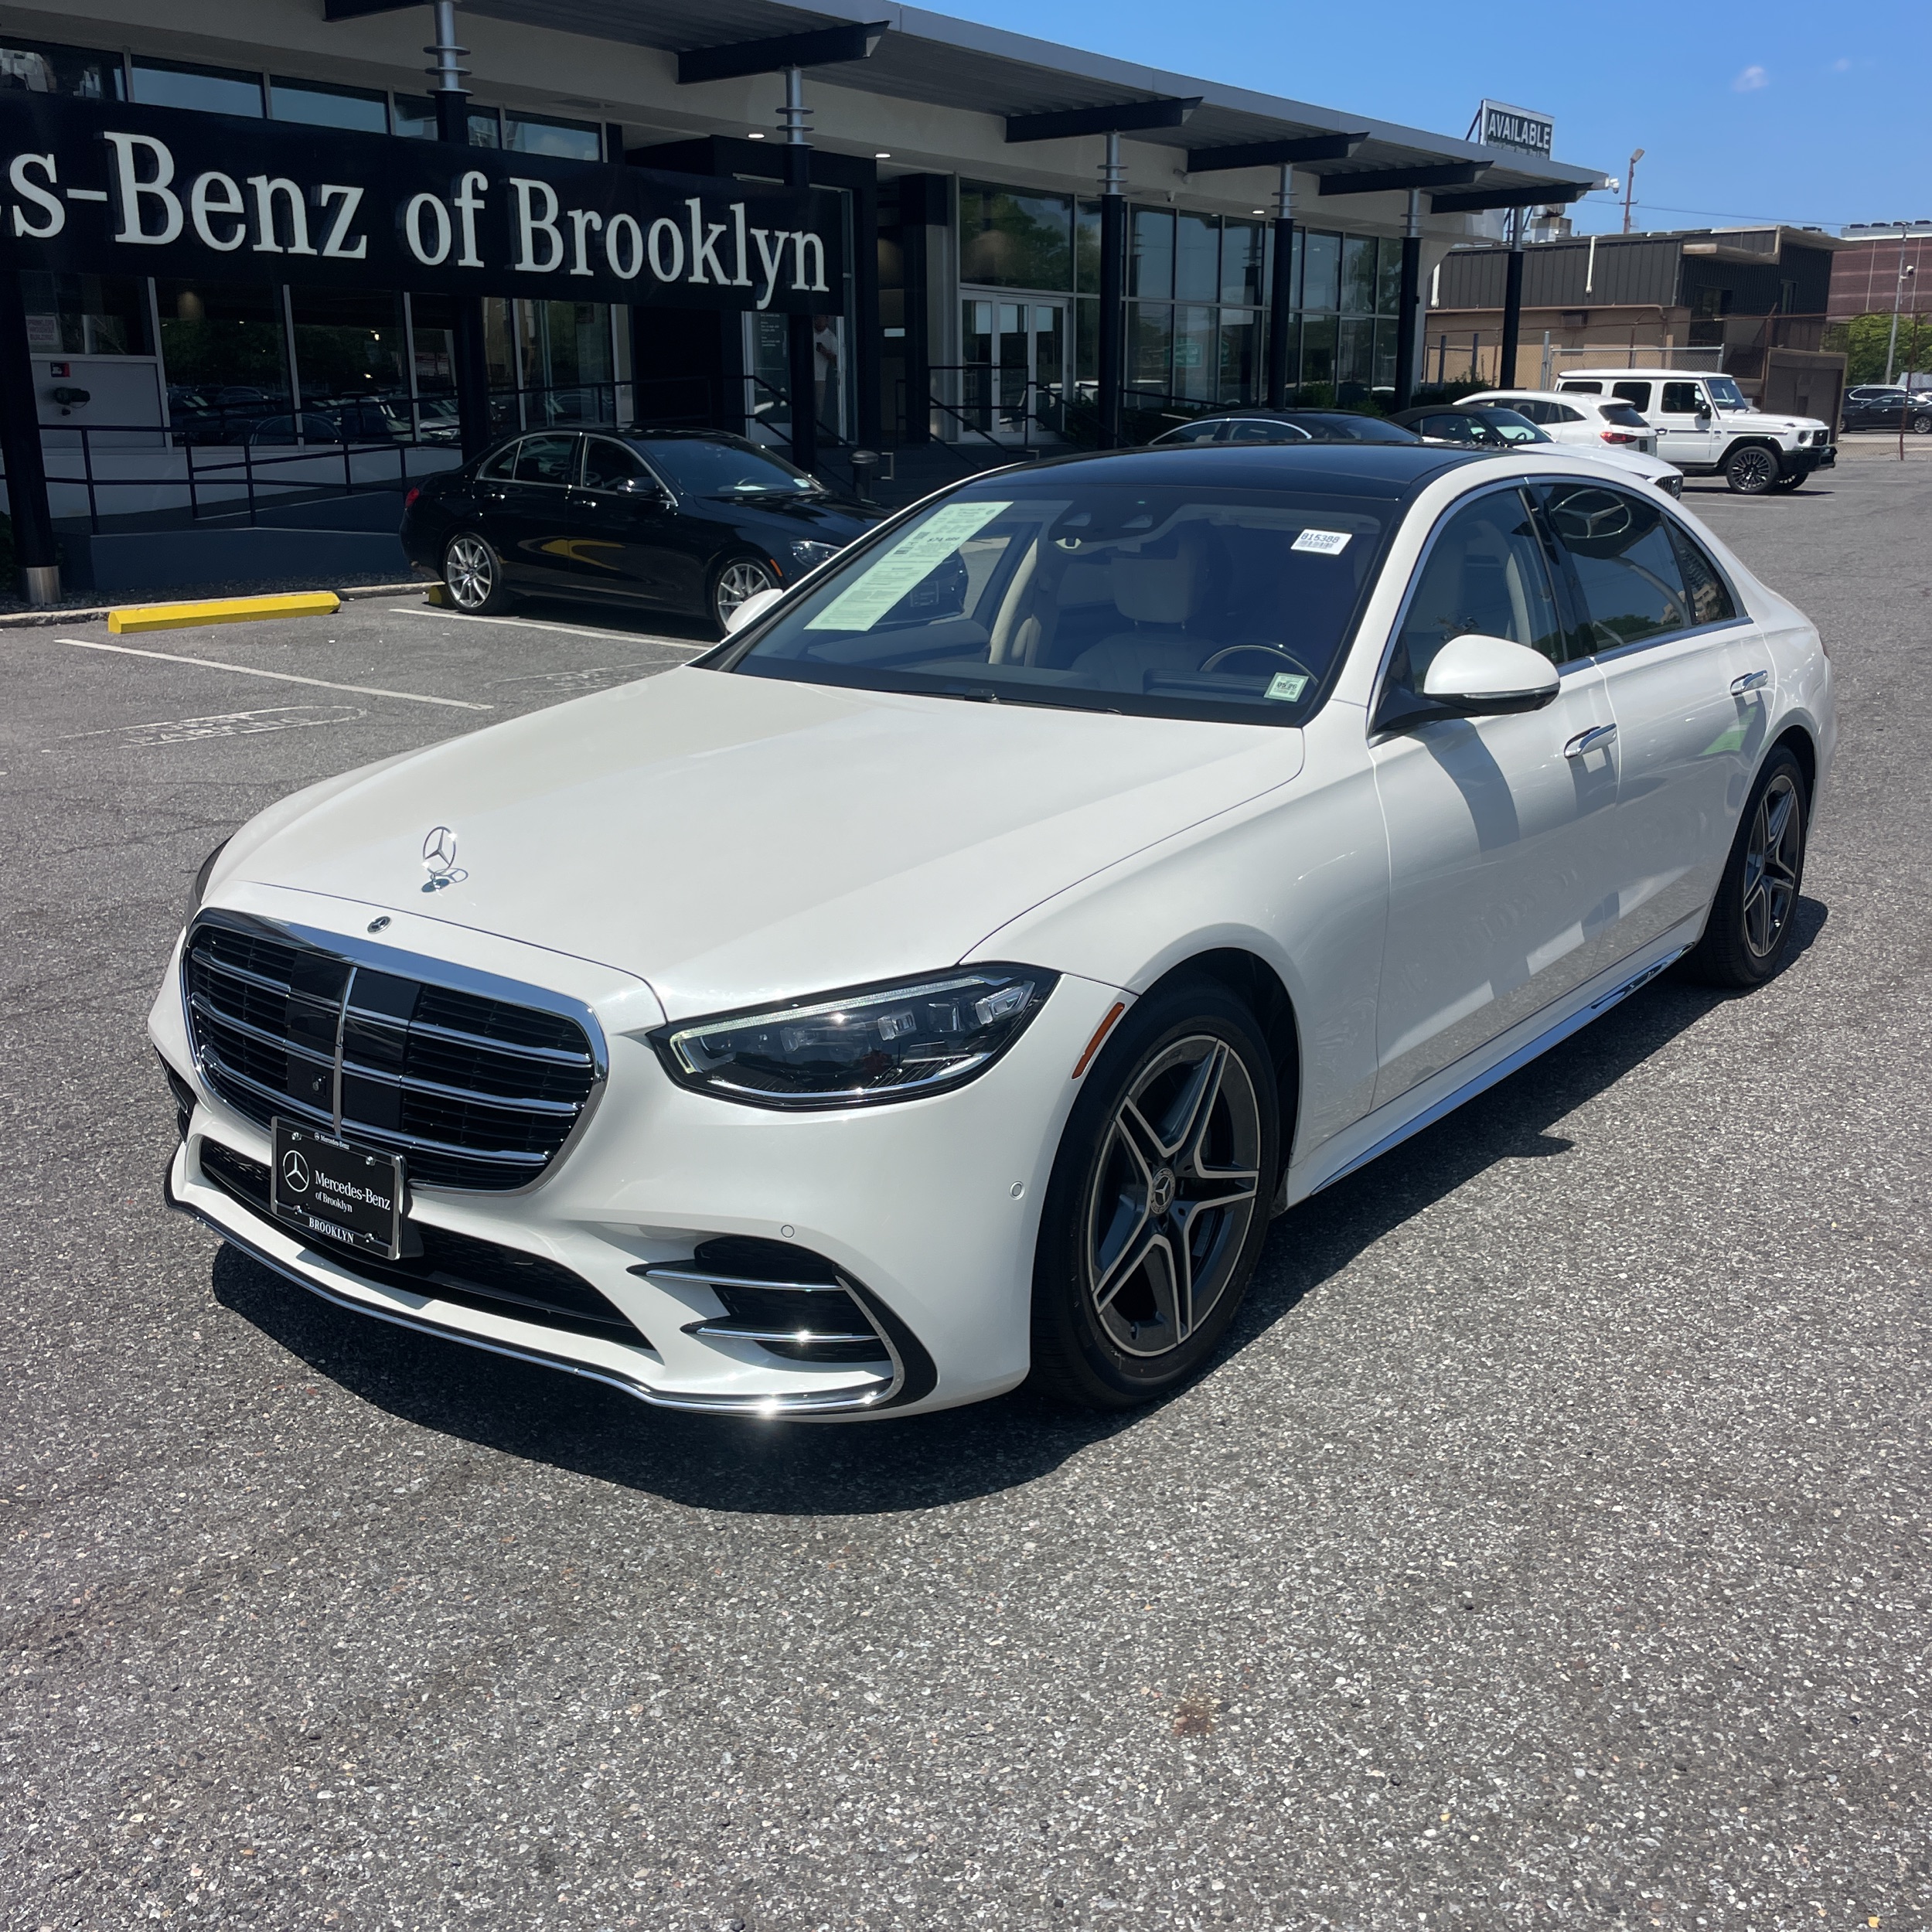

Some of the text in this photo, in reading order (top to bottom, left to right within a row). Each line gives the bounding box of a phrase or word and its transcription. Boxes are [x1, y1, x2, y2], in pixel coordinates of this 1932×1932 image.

[1487, 113, 1550, 149] AVAILABLE
[0, 131, 830, 309] s-Benz of Brooklyn
[315, 1170, 391, 1211] Mercedes-Benz
[315, 1191, 353, 1213] of Brooklyn
[309, 1217, 354, 1243] BROOKLYN
